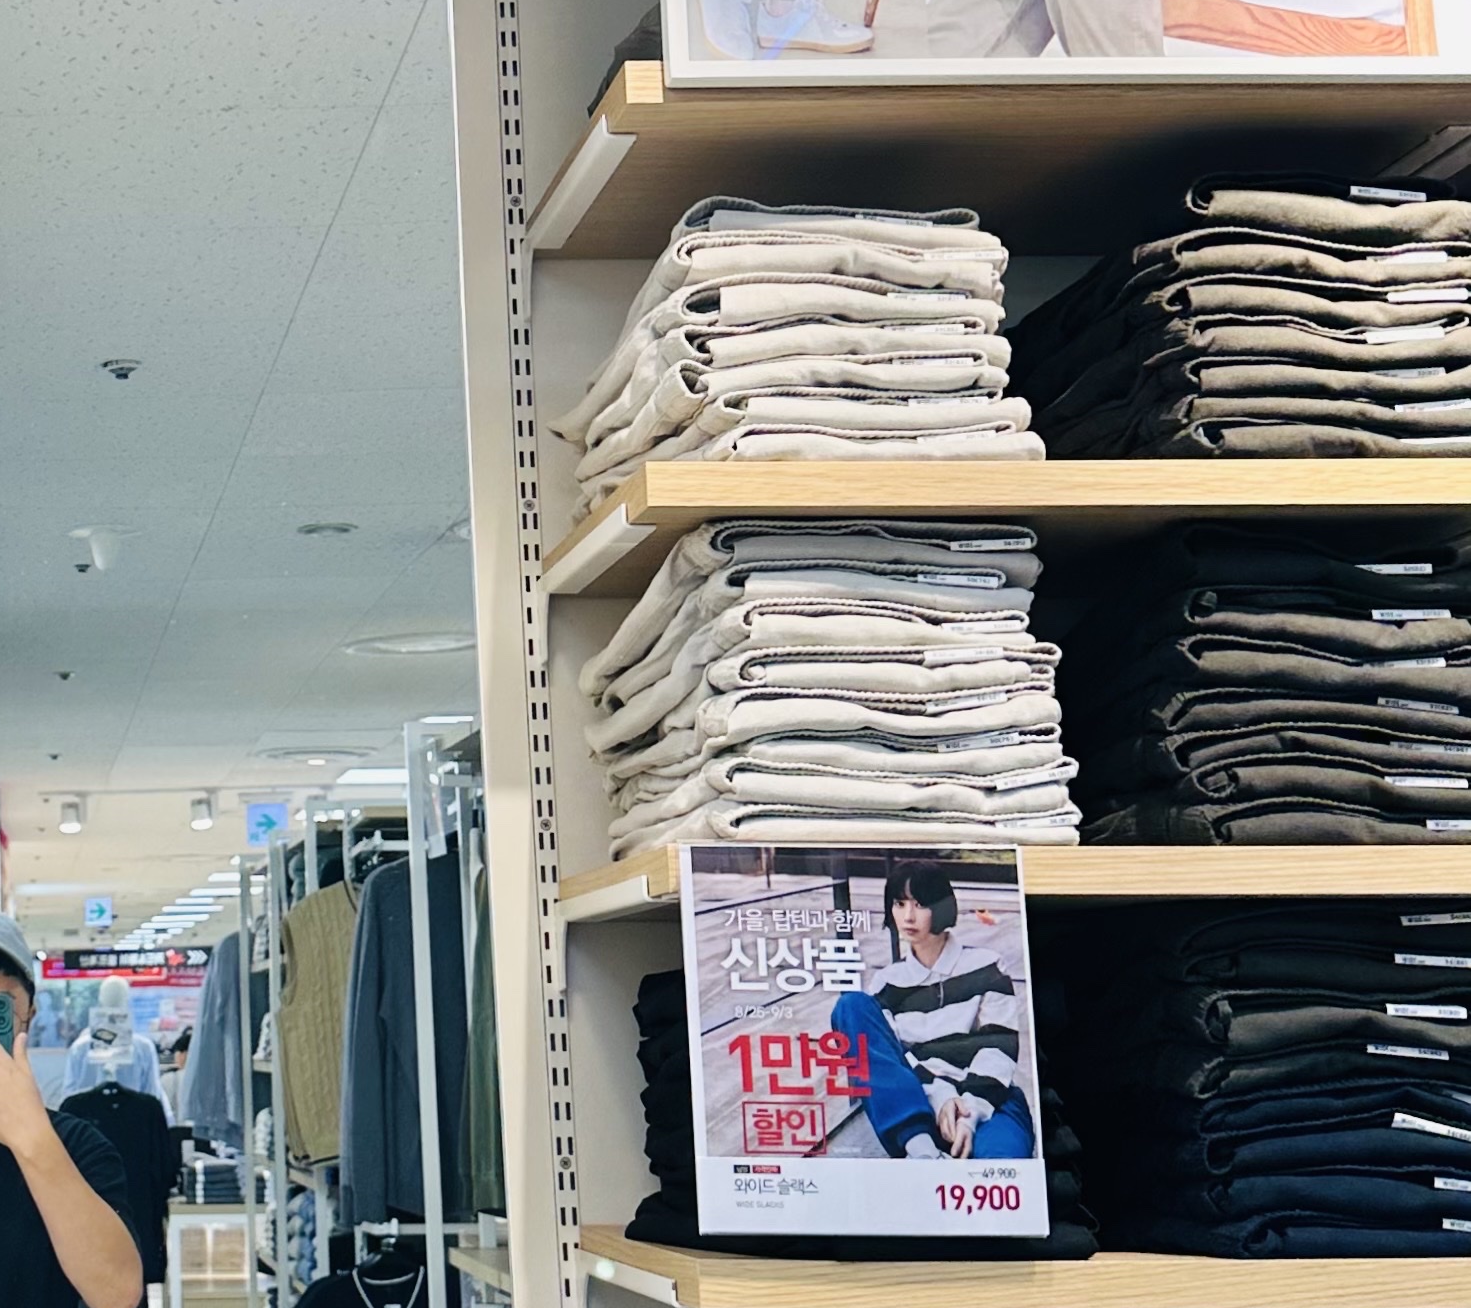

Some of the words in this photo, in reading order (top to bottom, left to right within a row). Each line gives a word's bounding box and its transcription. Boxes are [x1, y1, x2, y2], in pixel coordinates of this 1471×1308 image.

[724, 908, 769, 934] 가을,
[772, 909, 829, 932] 탑텐과
[832, 909, 872, 933] 함께
[720, 936, 866, 993] 신상품
[728, 1031, 872, 1097] 1만원
[752, 1108, 818, 1146] 할인
[734, 1177, 777, 1194] 와이드
[777, 1177, 820, 1195] 슬랙스
[935, 1184, 1020, 1215] 19,900
